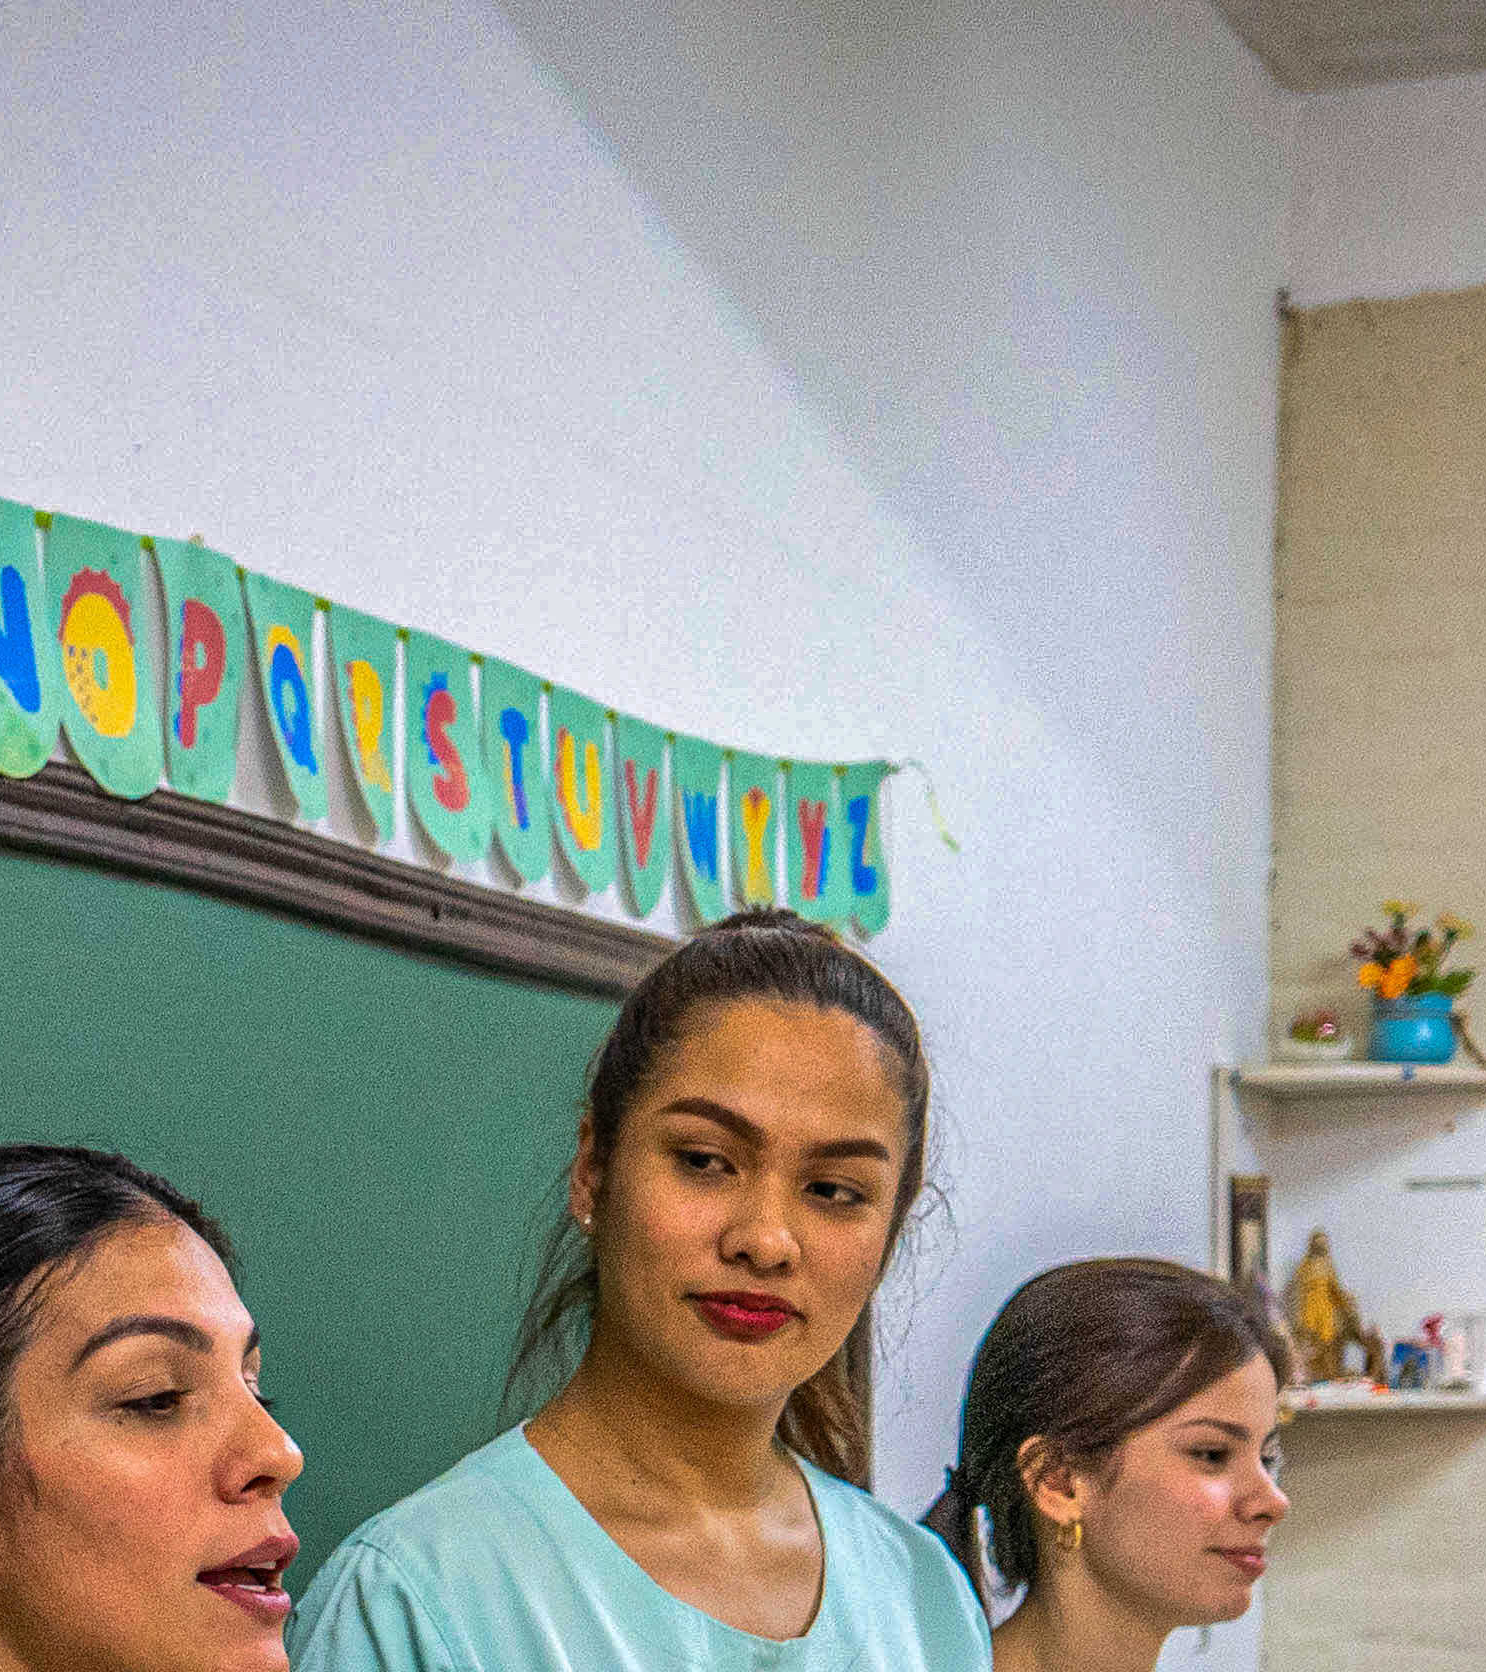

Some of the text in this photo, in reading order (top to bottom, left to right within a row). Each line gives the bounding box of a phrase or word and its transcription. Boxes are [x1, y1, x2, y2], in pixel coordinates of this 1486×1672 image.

[62, 592, 136, 739] O
[179, 598, 226, 750] P
[270, 642, 319, 777] Q
[349, 659, 394, 793] R
[424, 689, 471, 813] S
[500, 707, 531, 831] T
[563, 733, 601, 852] U
[624, 759, 659, 871] V
[740, 788, 773, 905] X
[797, 797, 827, 902] Y
